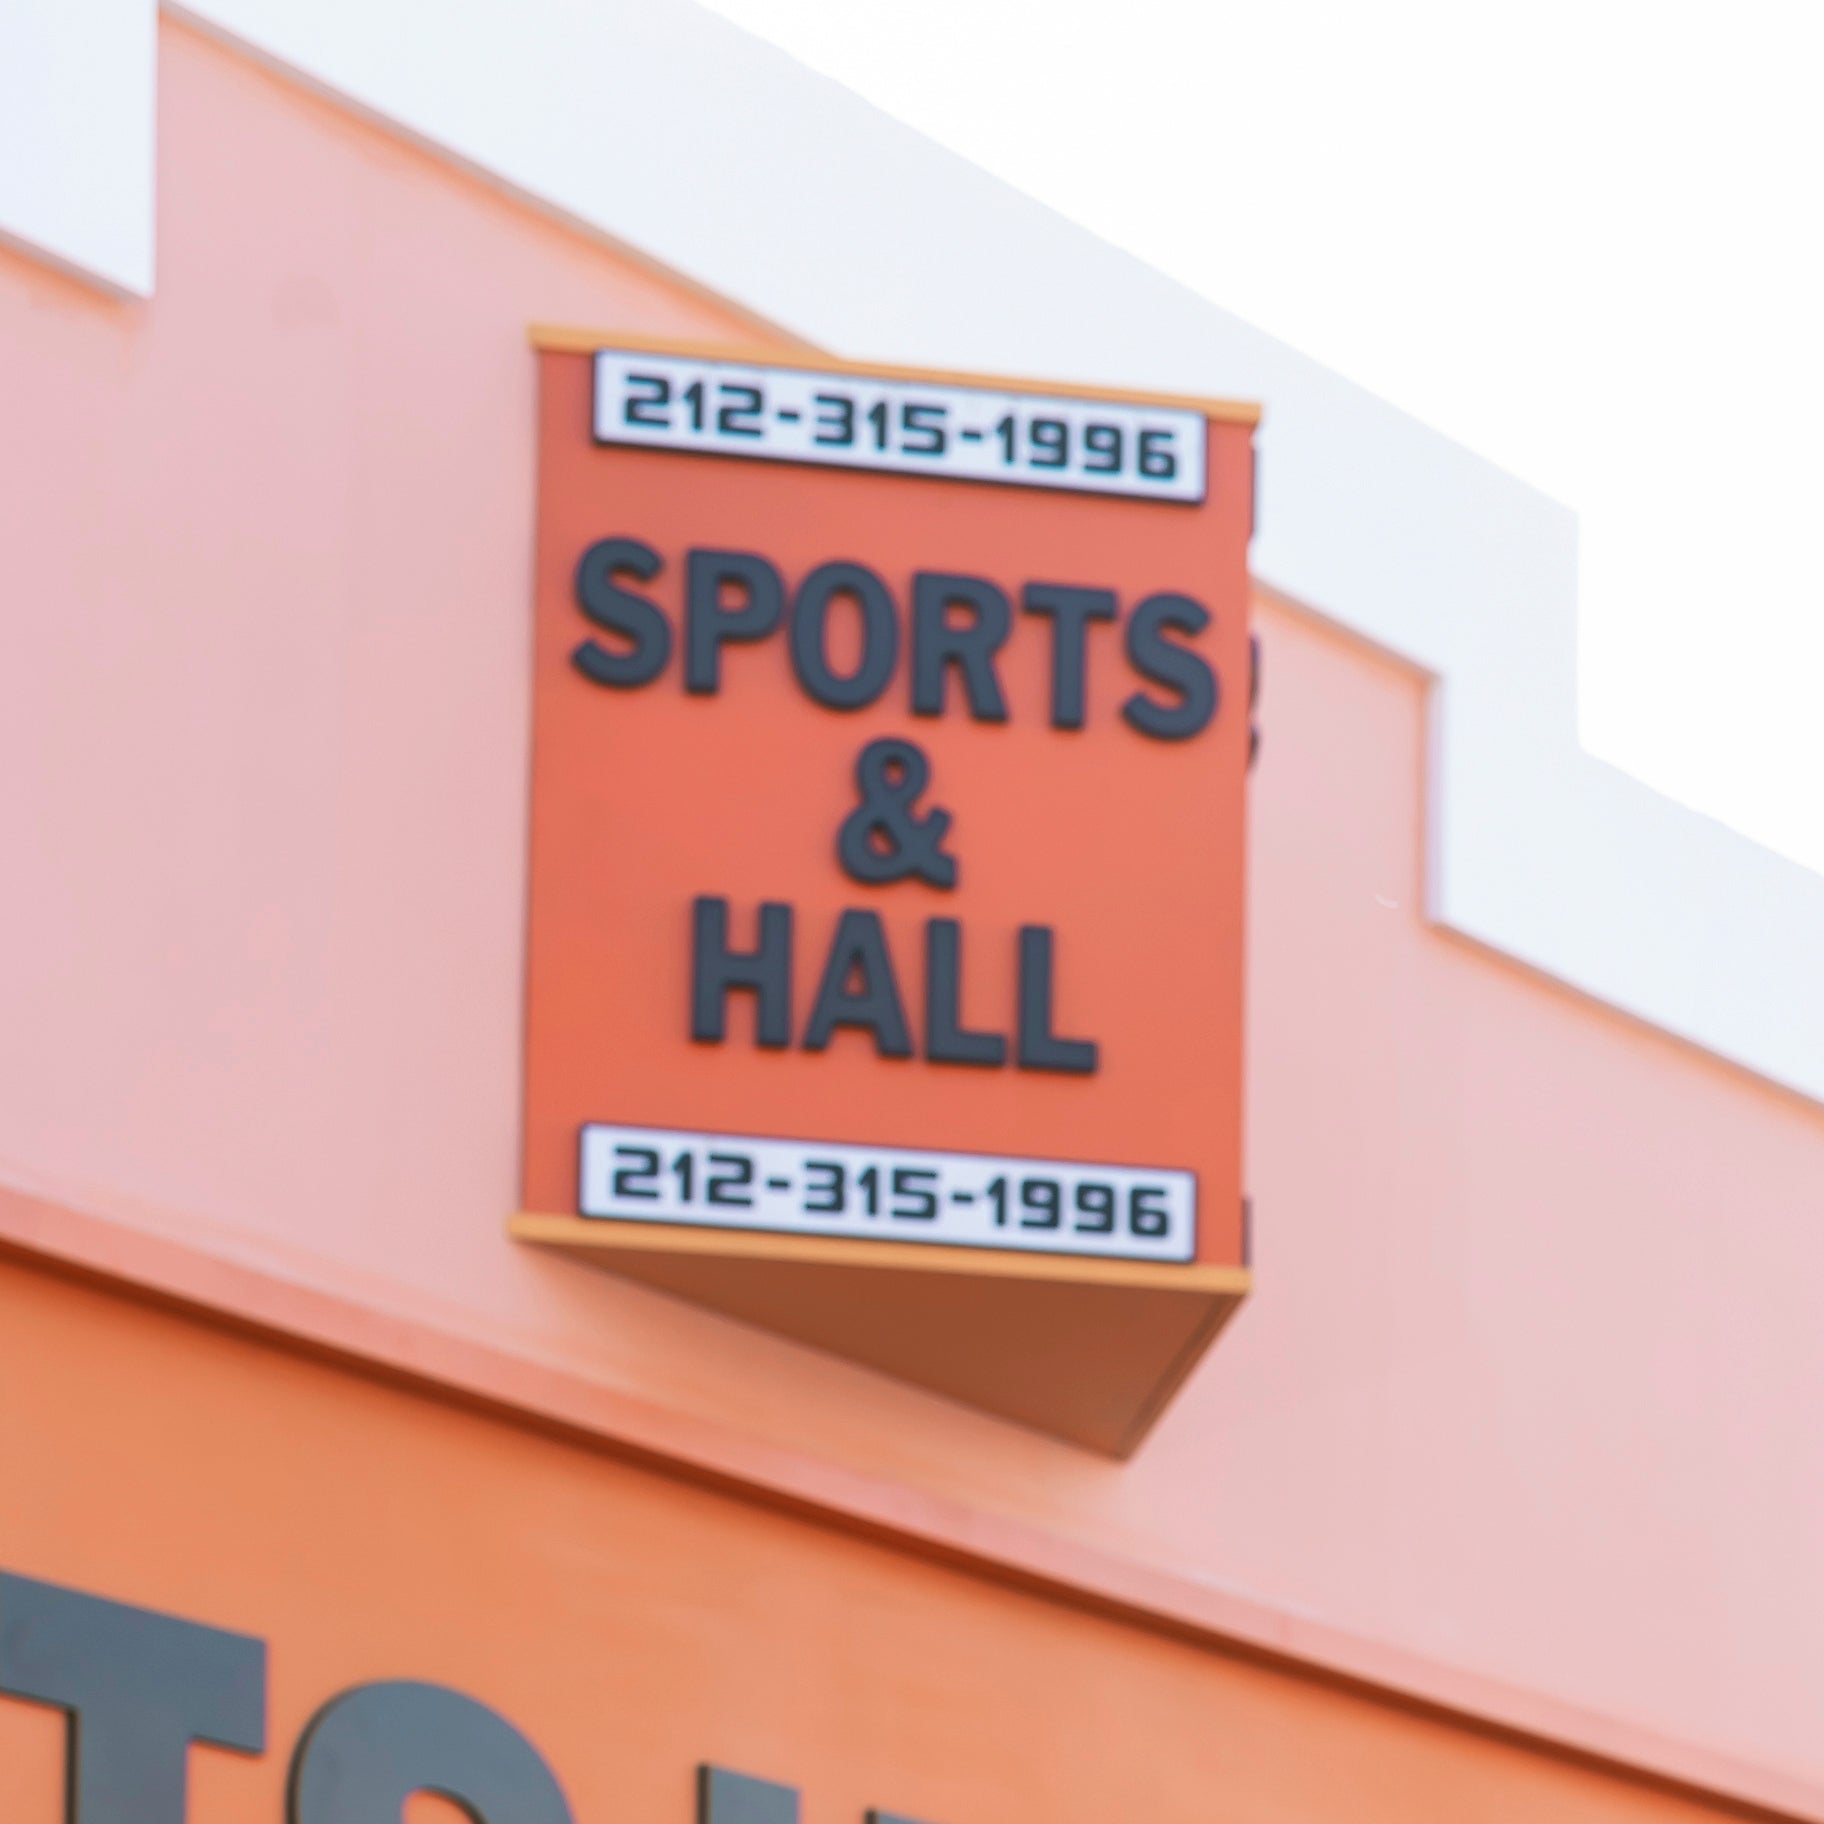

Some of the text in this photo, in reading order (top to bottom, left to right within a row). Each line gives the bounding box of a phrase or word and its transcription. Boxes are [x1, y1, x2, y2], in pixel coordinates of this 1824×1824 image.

[621, 371, 1180, 483] 212-315-1996
[570, 536, 1219, 744] SPORTS
[835, 736, 959, 892] &
[688, 894, 1100, 1076] HALL
[610, 1144, 1174, 1241] 212-315-1996
